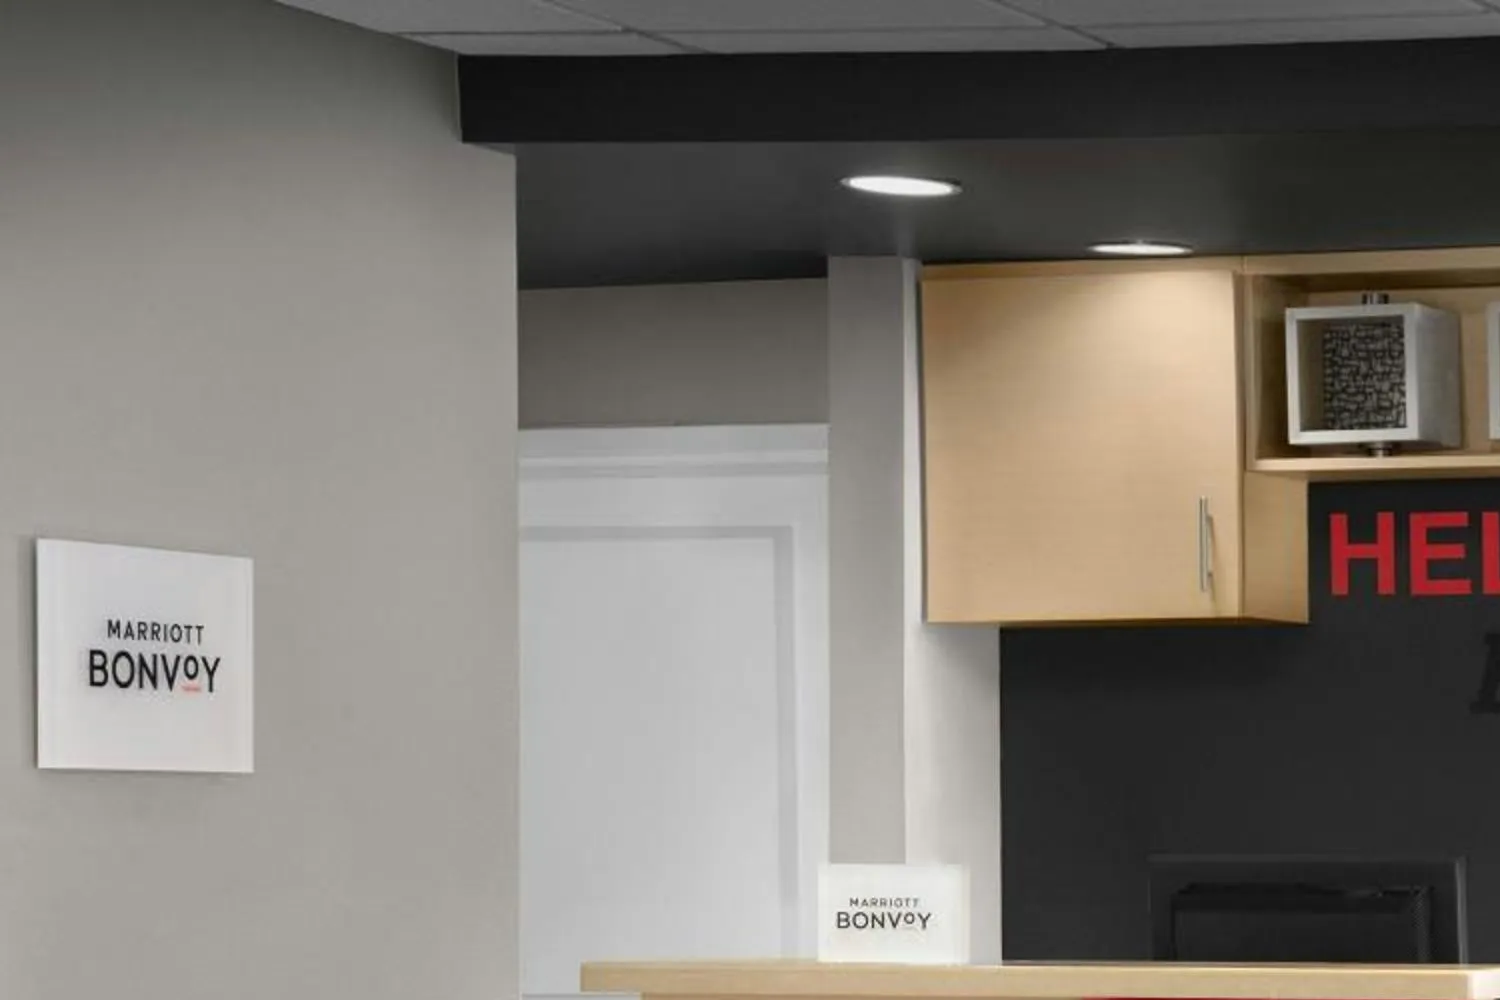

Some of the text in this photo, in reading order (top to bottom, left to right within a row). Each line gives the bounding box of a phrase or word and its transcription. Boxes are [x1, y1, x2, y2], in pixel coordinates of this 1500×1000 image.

[107, 619, 205, 645] MARRIOTT
[88, 648, 221, 693] BONVOY
[849, 897, 920, 909] MARRIOTT
[836, 911, 932, 931] BONVOY
